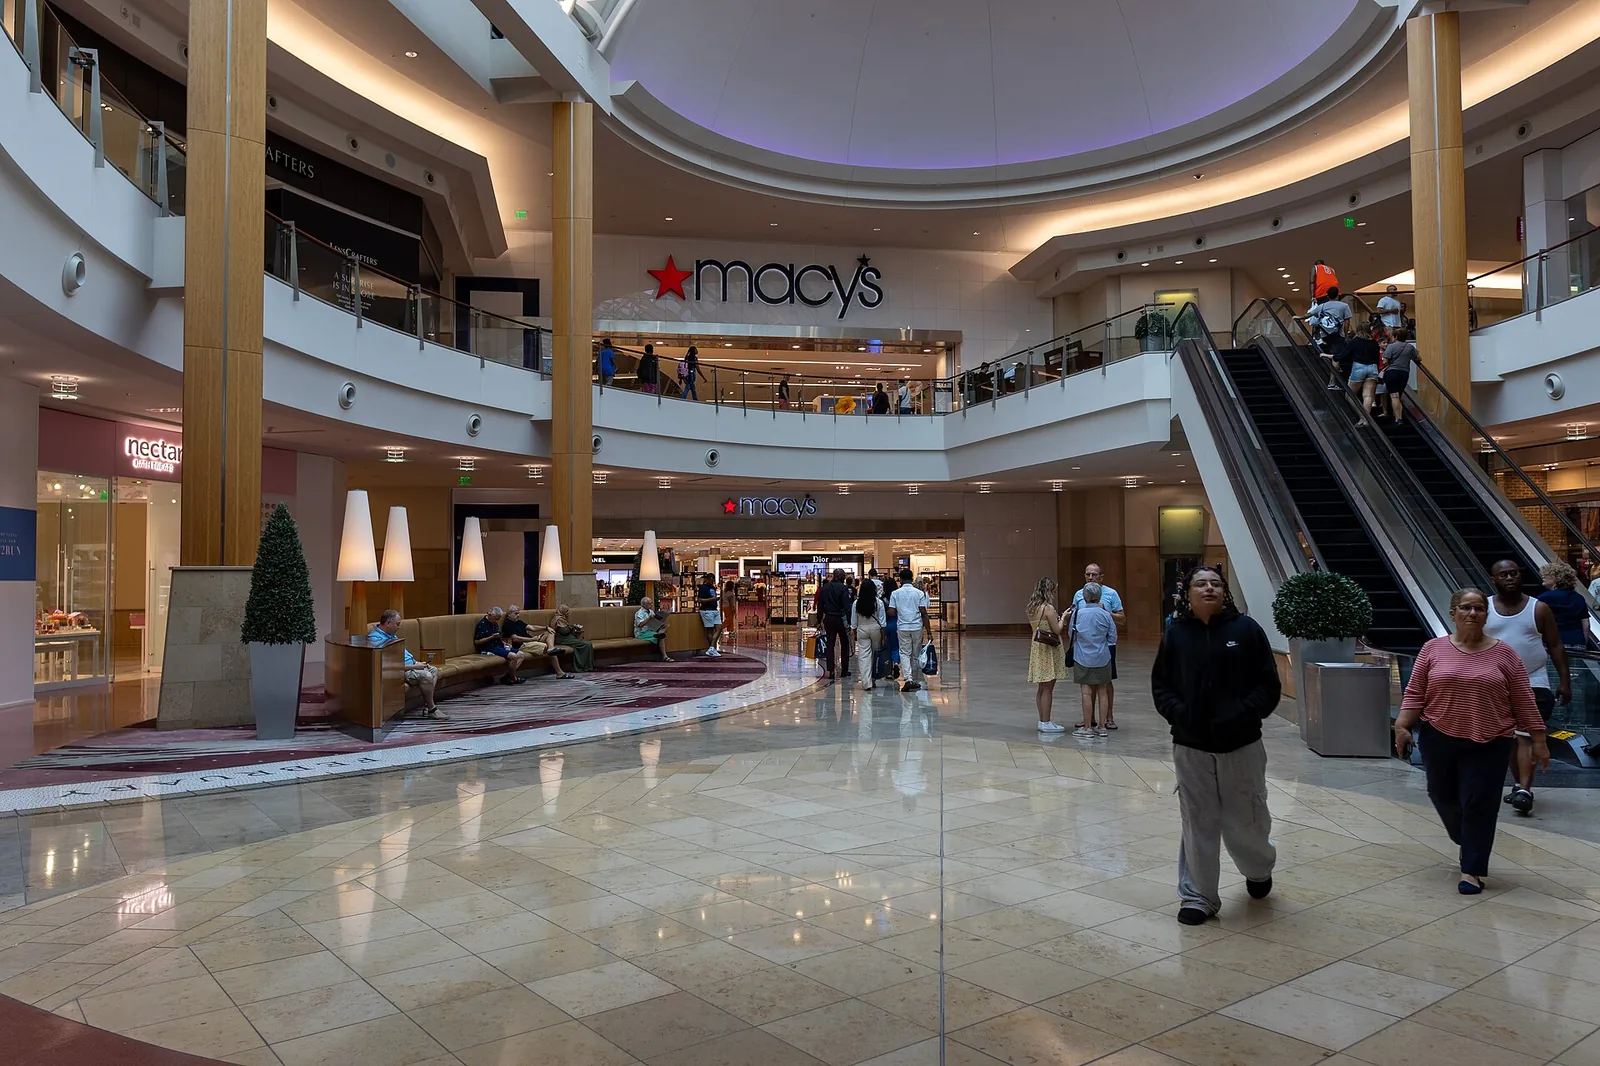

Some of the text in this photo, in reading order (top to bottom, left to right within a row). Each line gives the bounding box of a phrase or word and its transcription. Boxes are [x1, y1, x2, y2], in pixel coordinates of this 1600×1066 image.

[333, 271, 374, 290] A SURRISE
[126, 437, 183, 462] nectar
[812, 555, 829, 563] Dior
[56, 755, 381, 798] FEBRUARY
